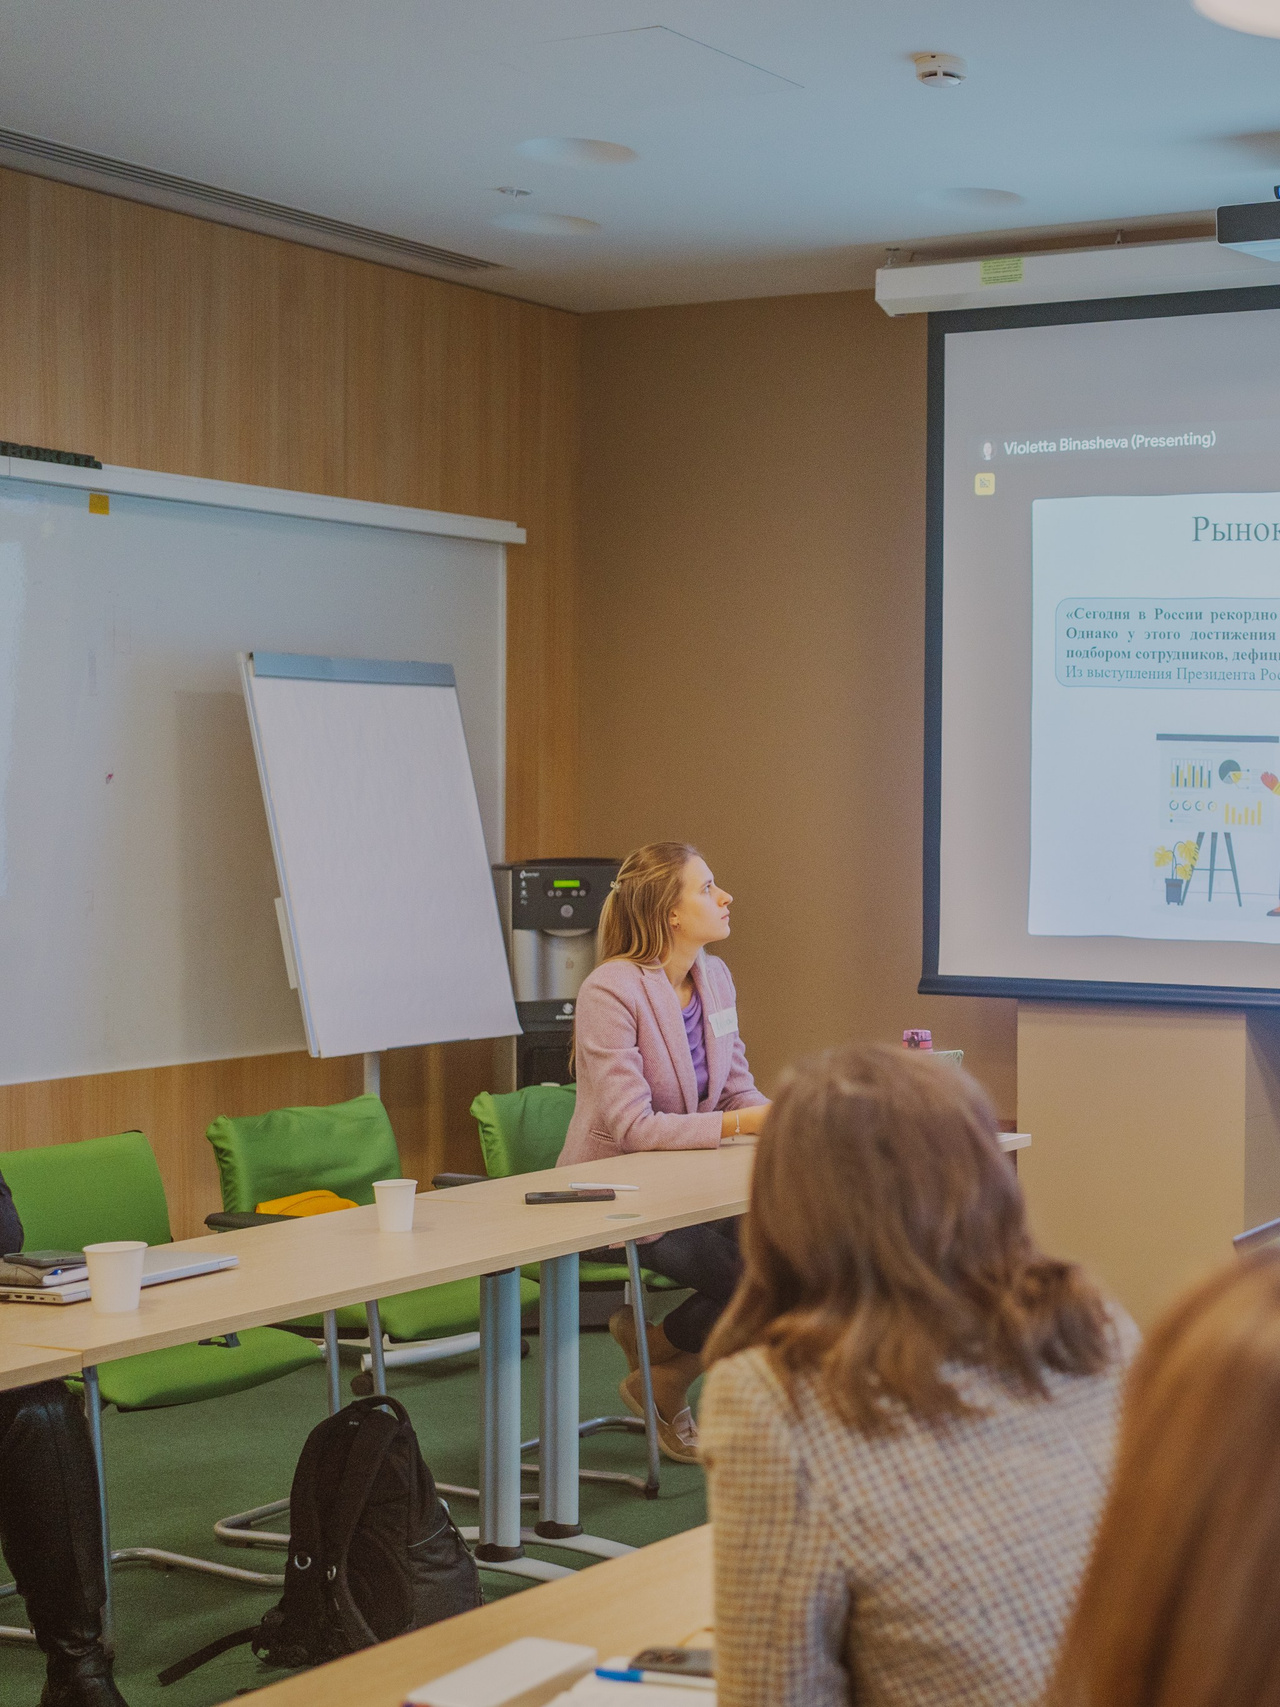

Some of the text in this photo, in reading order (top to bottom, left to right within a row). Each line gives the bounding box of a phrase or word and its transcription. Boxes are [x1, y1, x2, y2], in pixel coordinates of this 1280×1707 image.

[1004, 430, 1216, 455] Violetta Binasheva (Presenting)
[1066, 608, 1130, 621] «Сегодня
[1139, 611, 1146, 620] в
[1154, 608, 1202, 621] России
[1211, 609, 1278, 624] рекордно
[1066, 627, 1118, 639] Однако
[1128, 631, 1134, 643] у
[1144, 629, 1180, 640] этого
[1190, 629, 1276, 641] достижения
[1066, 646, 1131, 662] подбором
[1135, 651, 1228, 663] сотрудников,
[1066, 665, 1082, 678] Из
[1087, 668, 1172, 682] выступления
[1177, 667, 1256, 684] Президента
